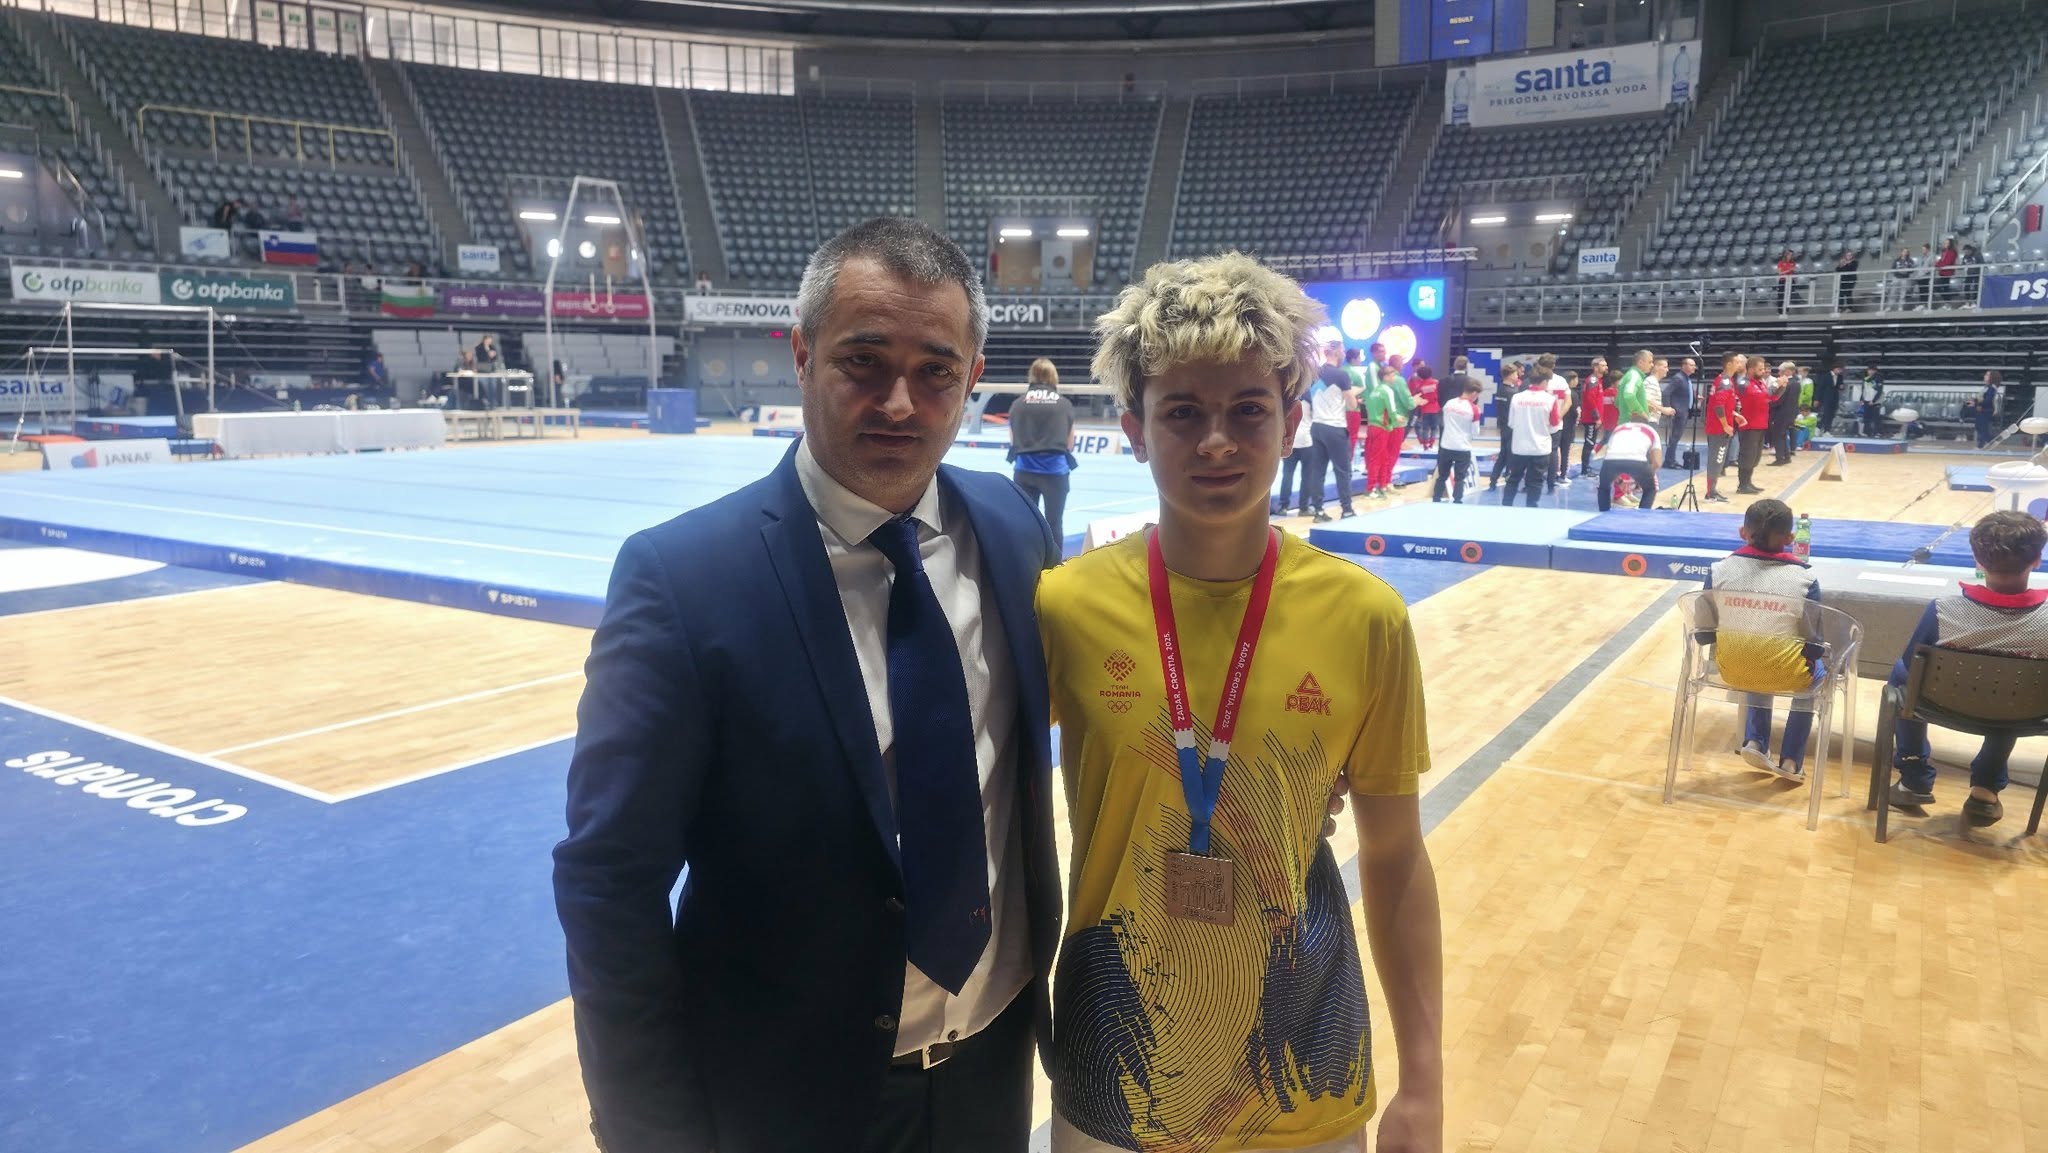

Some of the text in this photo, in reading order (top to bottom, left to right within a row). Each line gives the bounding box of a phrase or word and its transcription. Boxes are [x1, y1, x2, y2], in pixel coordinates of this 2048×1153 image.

[1514, 58, 1612, 94] santa
[1490, 84, 1648, 107] PRIRODNA IZVORSKA VODA
[1581, 251, 1617, 264] santa
[50, 273, 144, 296] otpbanka
[197, 279, 284, 302] otpbanka
[696, 301, 791, 318] SUPERNOVA
[1025, 389, 1060, 401] POLO
[1072, 436, 1109, 454] HEP
[1414, 545, 1447, 555] SPIETH
[500, 592, 538, 608] SPIETH
[1724, 596, 1788, 612] ROMANIA
[1099, 690, 1141, 698] ROMANIA
[1285, 693, 1332, 716] PEAK
[5, 750, 248, 826] cromaris
